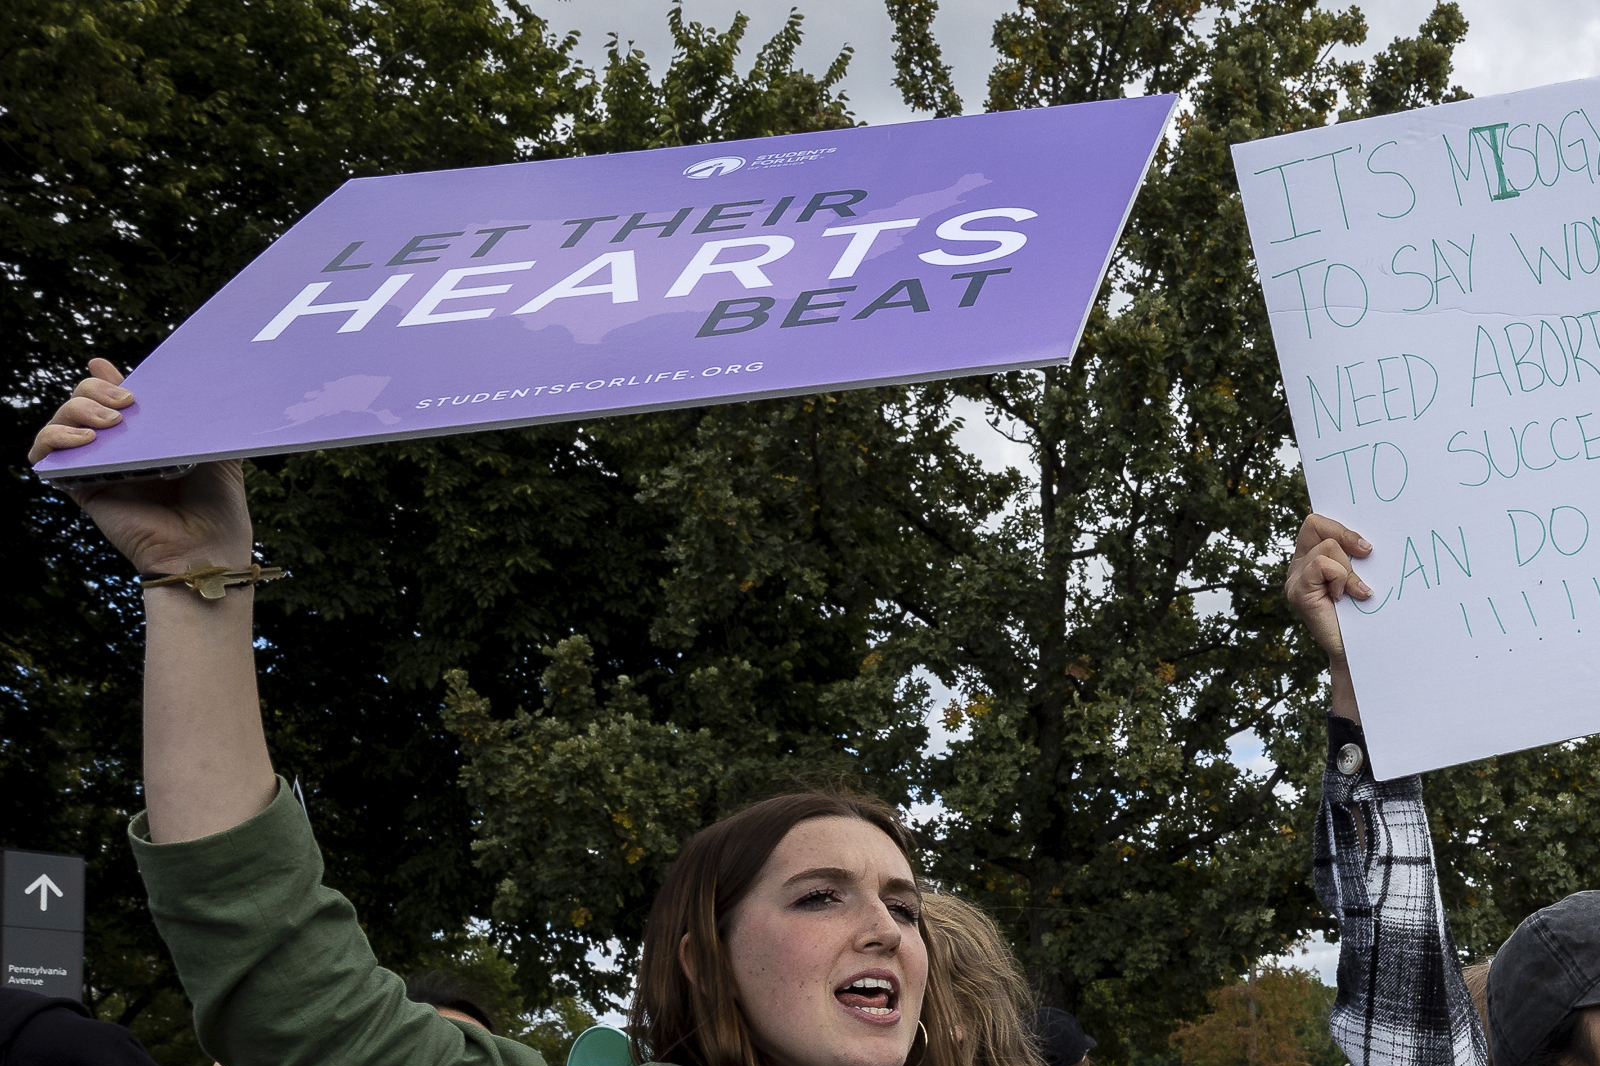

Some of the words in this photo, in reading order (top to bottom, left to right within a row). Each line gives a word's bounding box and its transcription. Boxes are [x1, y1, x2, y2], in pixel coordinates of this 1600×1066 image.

[751, 158, 785, 167] FOR
[755, 147, 838, 161] STUDENTS
[1253, 140, 1416, 244] IT'S
[320, 224, 532, 273] LET
[560, 189, 868, 249] THEIR
[250, 207, 1039, 343] HEARTS
[694, 267, 1013, 339] BEAT
[1272, 259, 1368, 339] TO
[1392, 233, 1475, 312] SAY
[415, 361, 765, 410] STUDENTSFORLIFE.ORG
[1307, 353, 1439, 438] NEED
[1316, 441, 1408, 504] TO
[1507, 505, 1590, 567] DO
[8, 964, 68, 977] Pennsylvania
[8, 976, 44, 986] Avenue
